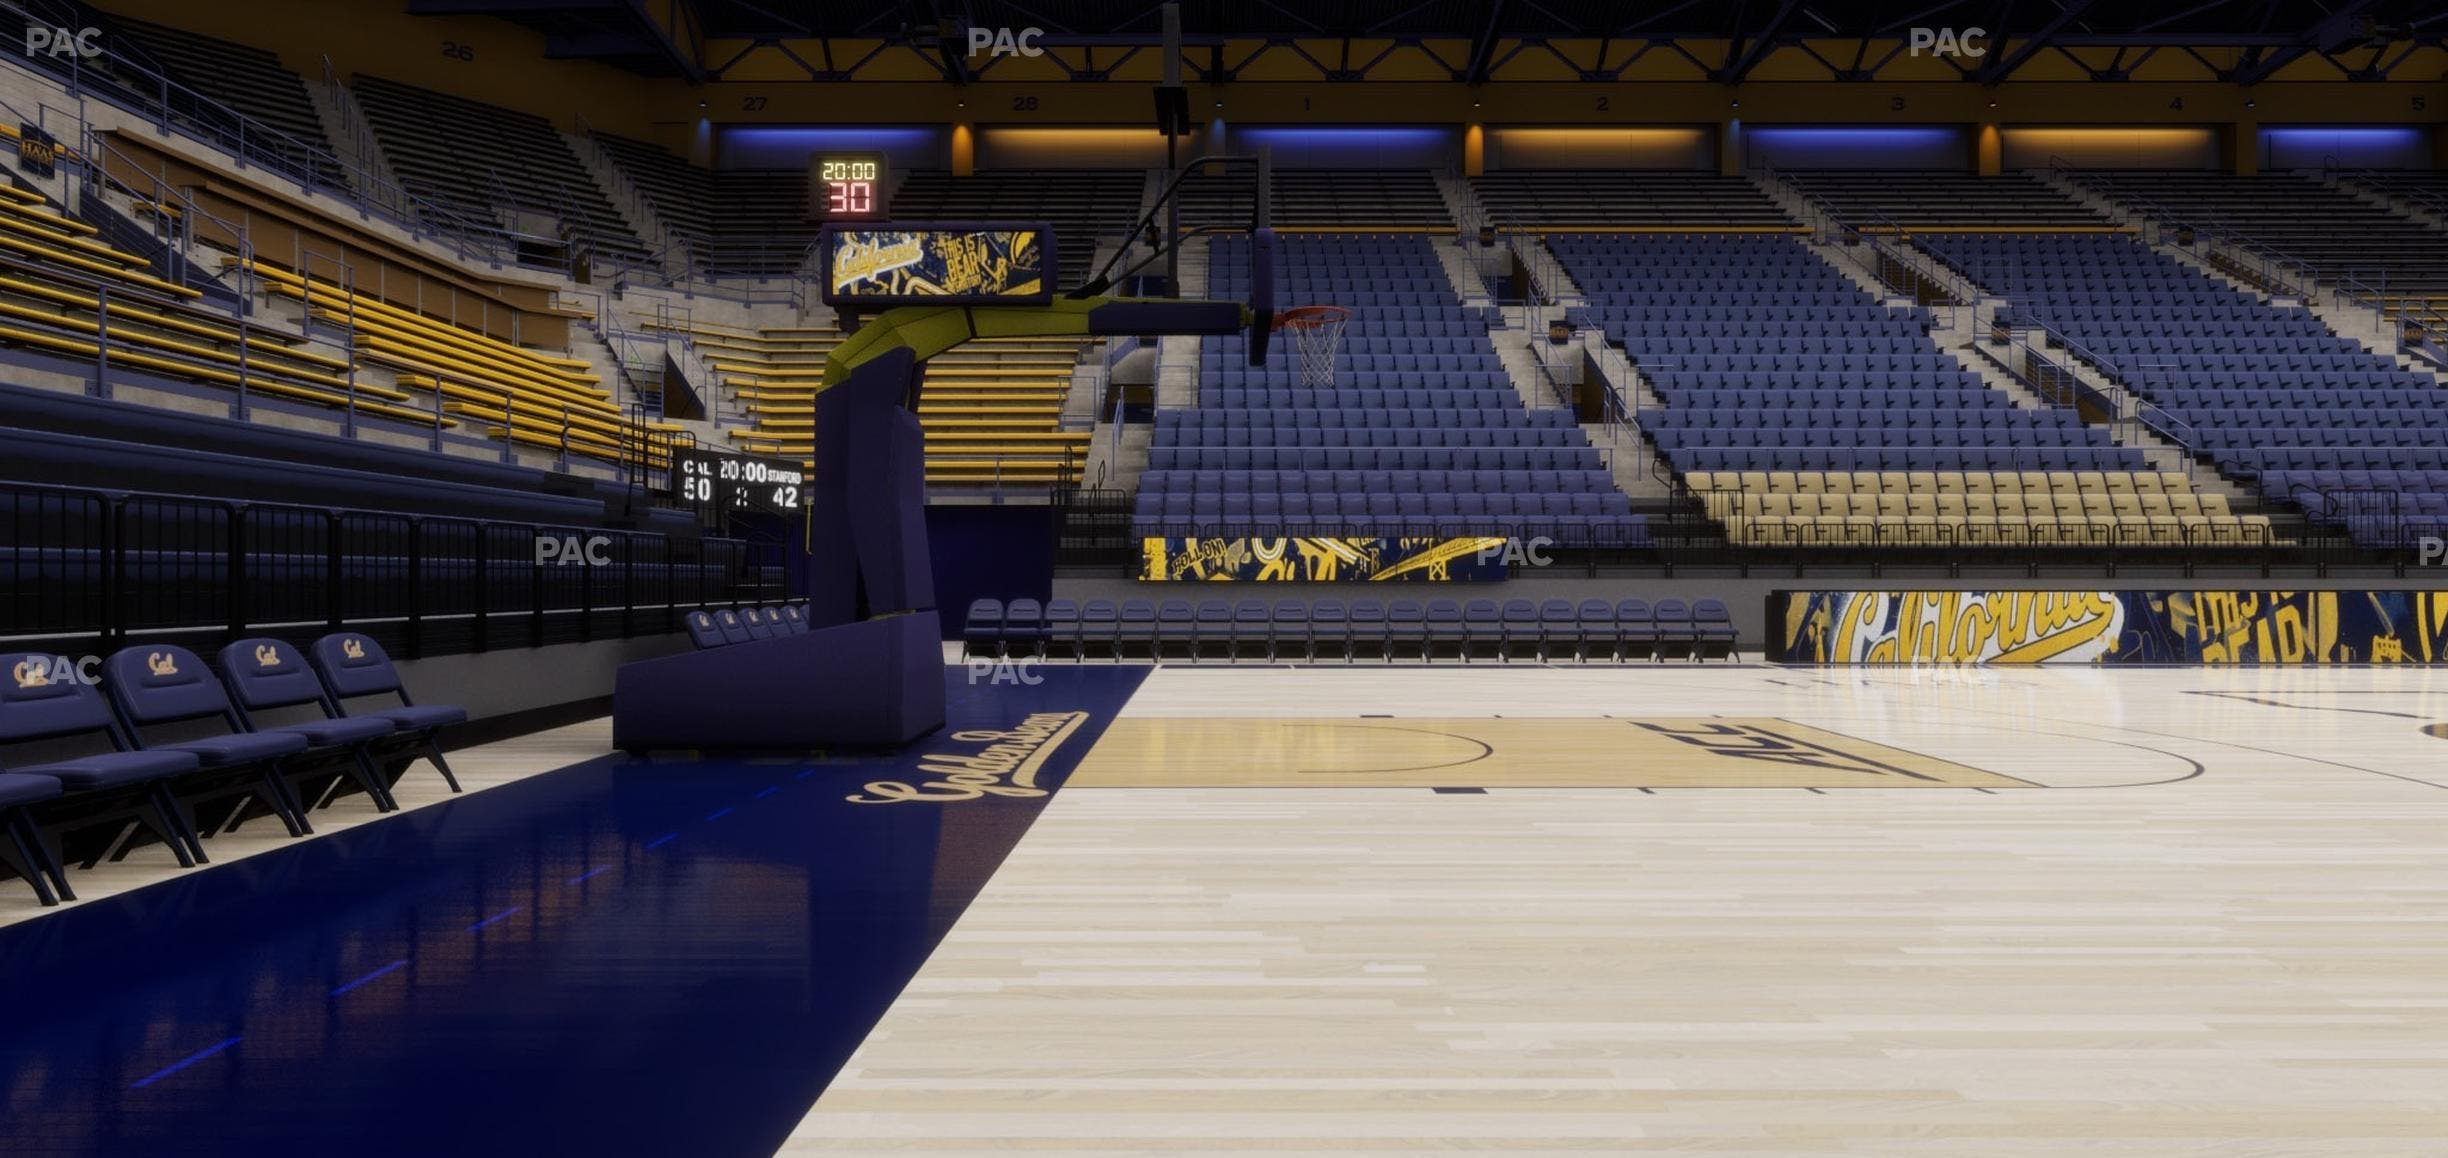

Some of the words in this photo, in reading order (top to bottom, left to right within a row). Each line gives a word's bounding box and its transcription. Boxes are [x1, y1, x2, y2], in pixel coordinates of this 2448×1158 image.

[441, 41, 474, 62] 26
[743, 97, 767, 111] 27
[1014, 96, 1039, 111] 28
[1597, 97, 1609, 111] 2
[823, 162, 875, 180] 20:00
[829, 182, 869, 212] 30
[964, 233, 976, 252] IS
[946, 251, 981, 281] BEAR
[720, 459, 767, 483] 20:00
[767, 469, 802, 485] STANFORD
[684, 477, 711, 501] 50
[773, 486, 798, 508] 42
[255, 645, 280, 667] Cal
[344, 639, 365, 658] Cal
[148, 652, 178, 676] Cal
[846, 744, 1048, 803] Golden
